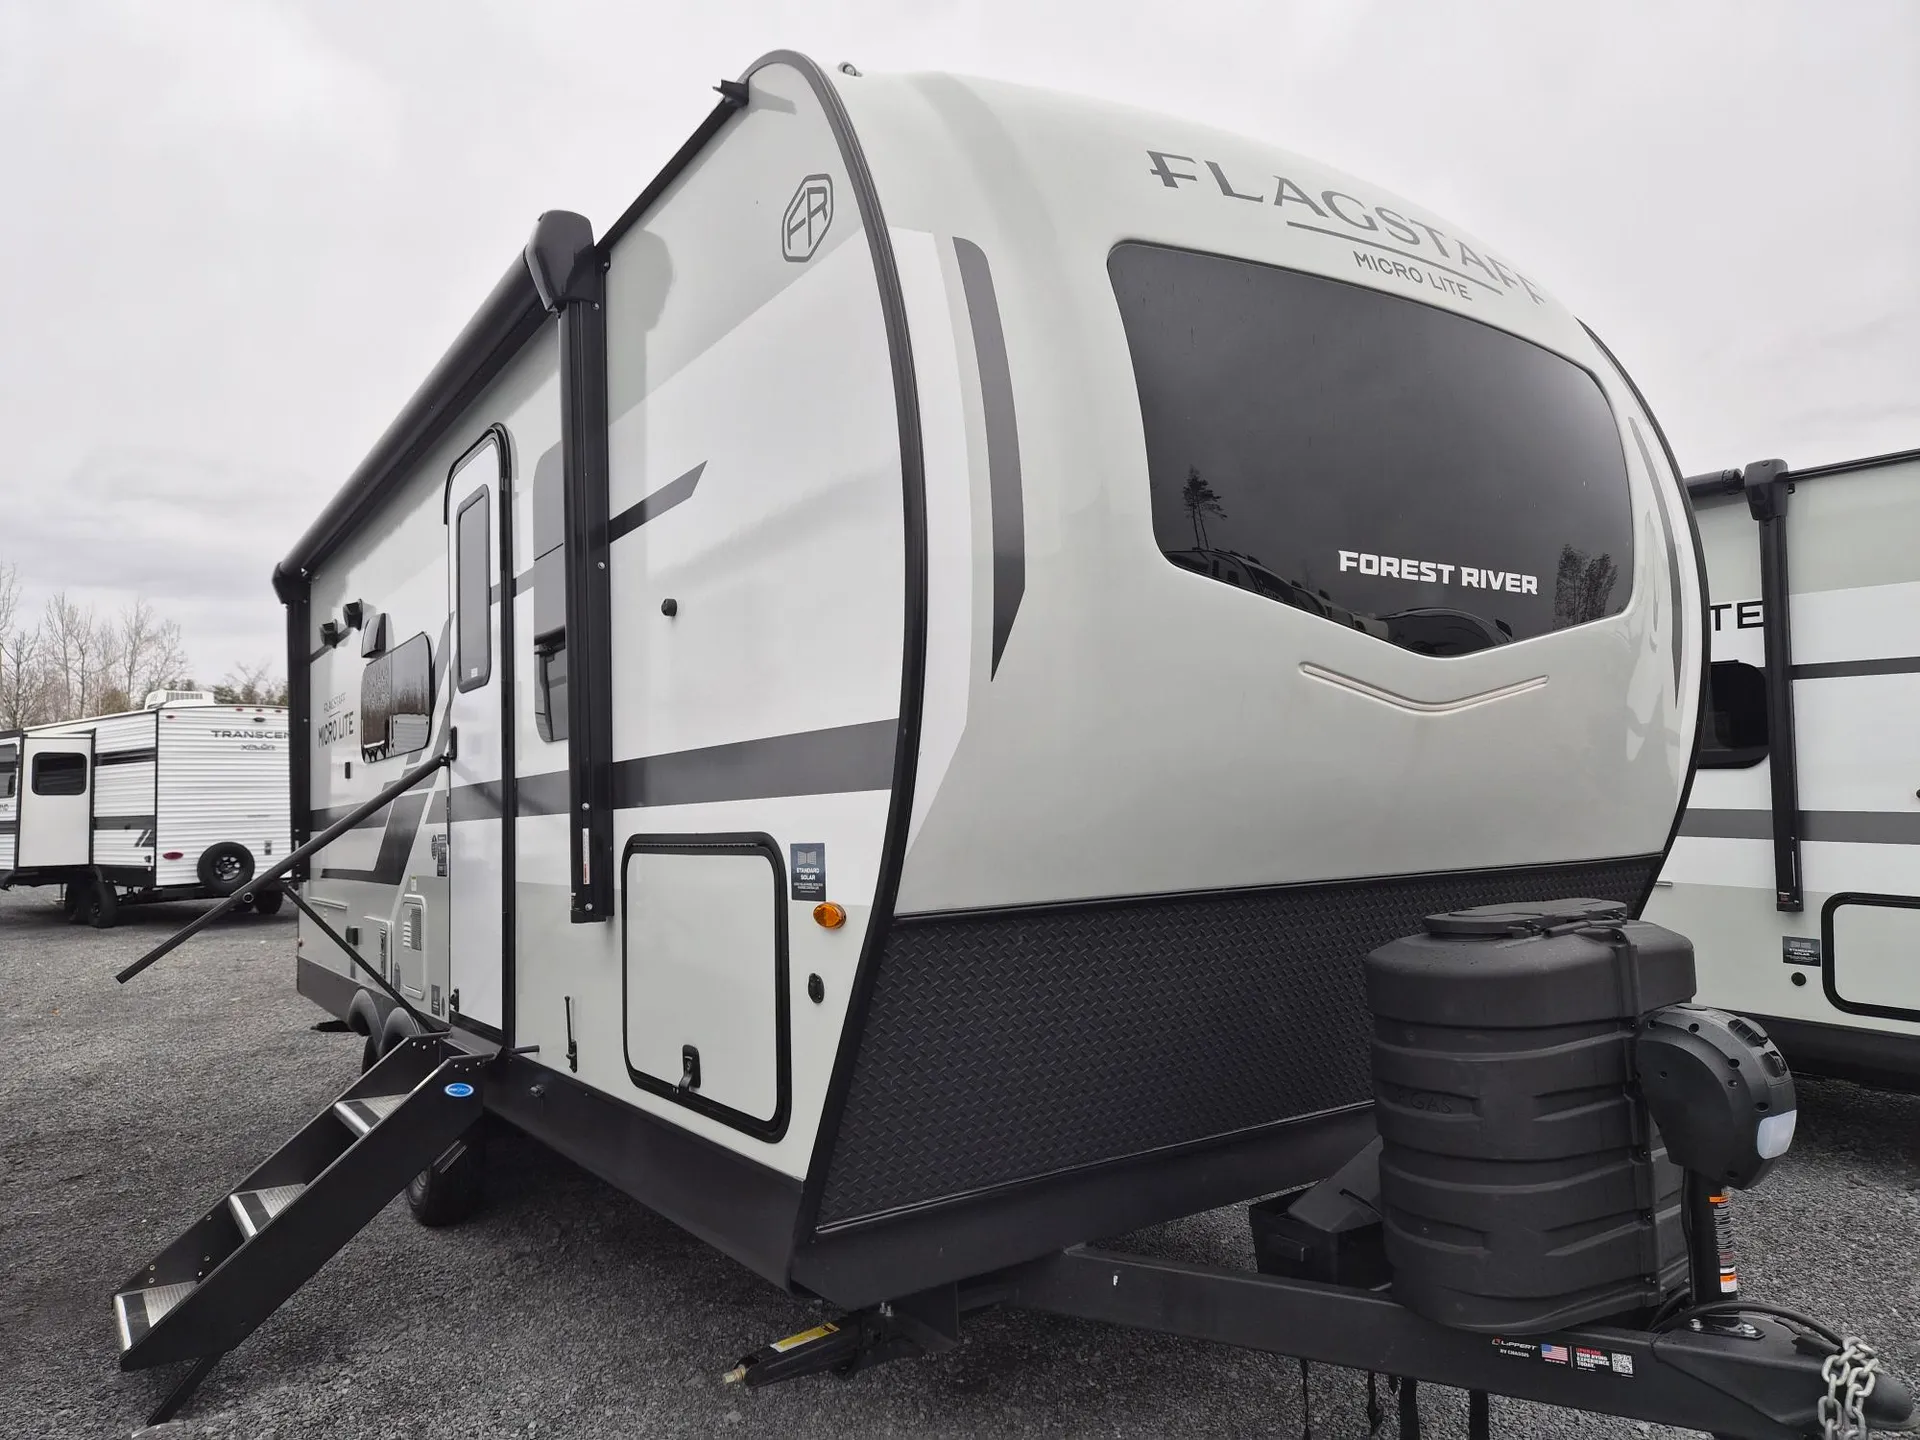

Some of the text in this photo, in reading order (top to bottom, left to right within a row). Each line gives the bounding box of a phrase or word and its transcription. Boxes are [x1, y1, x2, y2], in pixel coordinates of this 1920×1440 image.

[1147, 150, 1545, 304] FLAGSTAFF
[1352, 249, 1473, 301] MICRO LITE
[1338, 550, 1538, 595] FOREST RIVER
[339, 711, 354, 739] LITE
